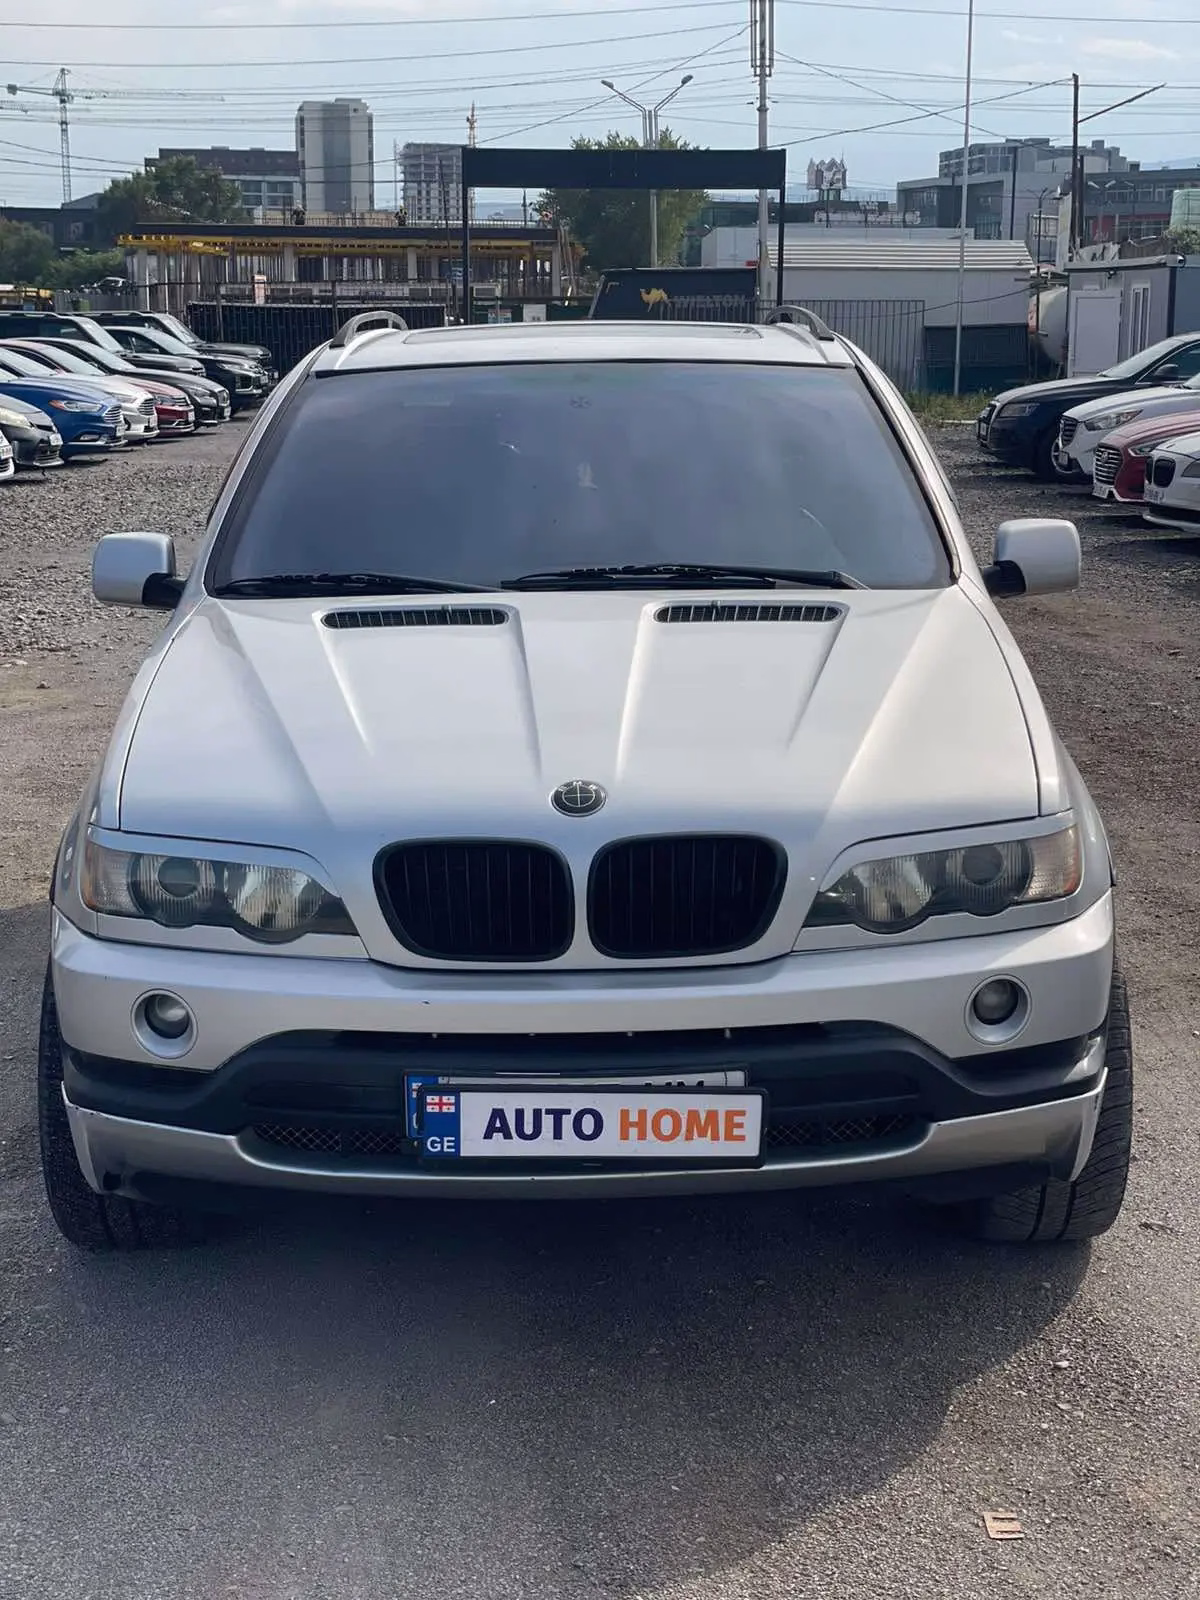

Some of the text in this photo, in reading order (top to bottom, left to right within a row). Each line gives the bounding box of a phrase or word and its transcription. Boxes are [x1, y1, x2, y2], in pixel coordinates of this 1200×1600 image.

[483, 1107, 747, 1142] AUTO HOME
[426, 1136, 456, 1153] GE
